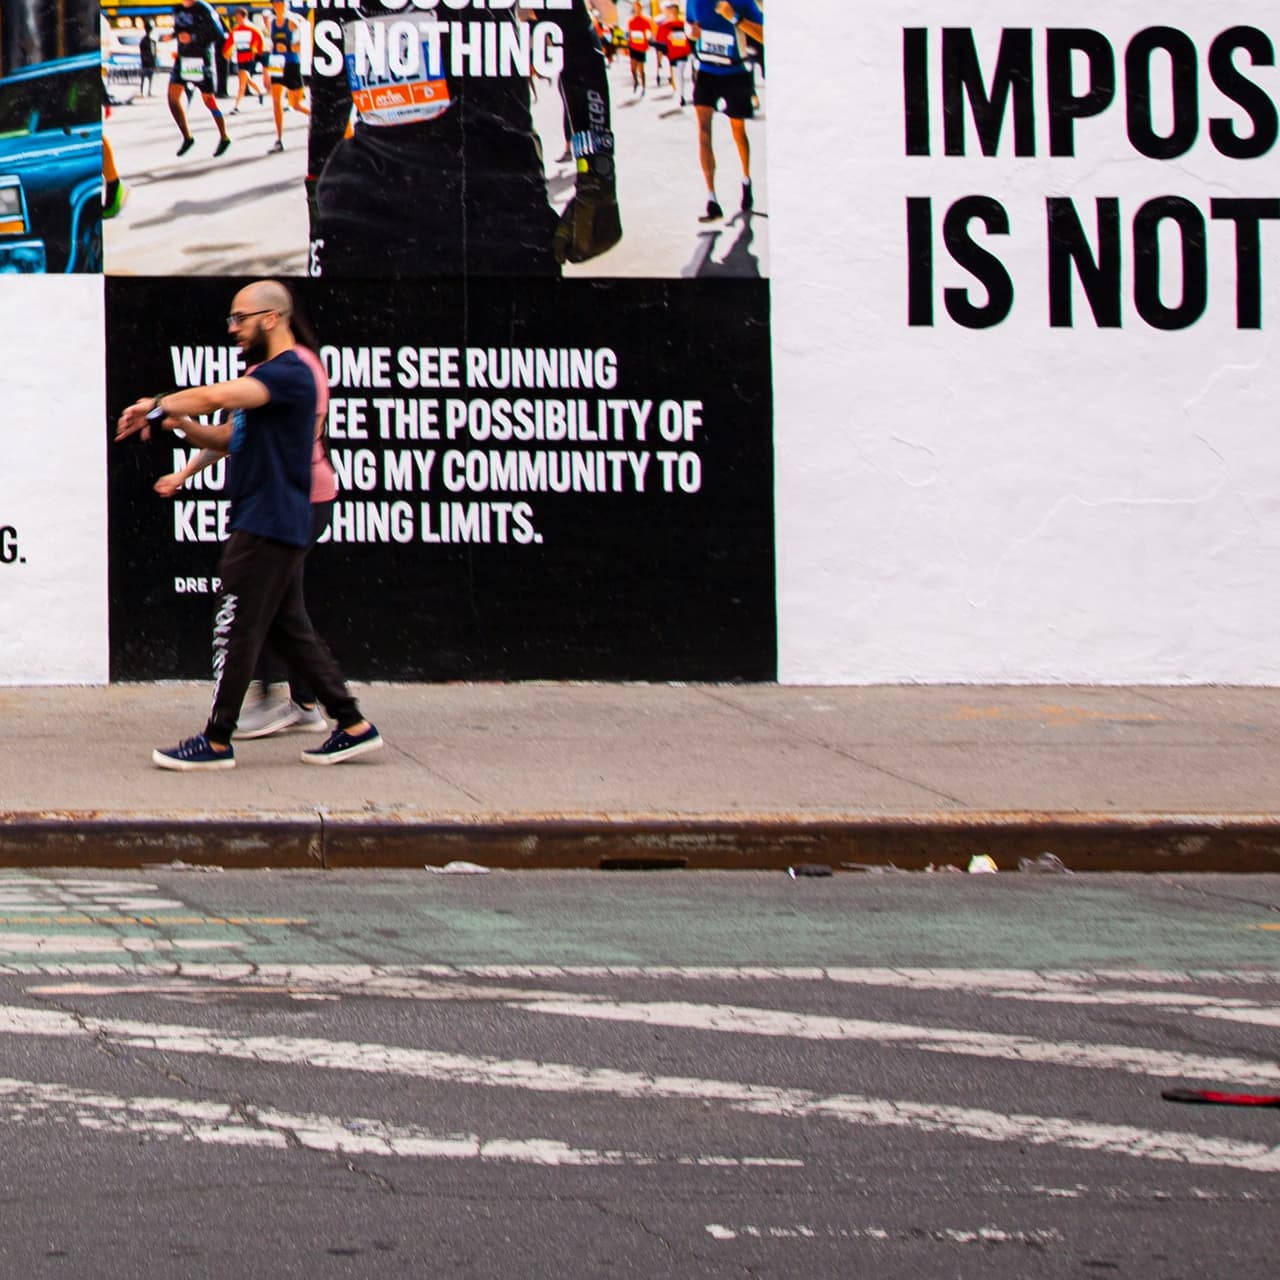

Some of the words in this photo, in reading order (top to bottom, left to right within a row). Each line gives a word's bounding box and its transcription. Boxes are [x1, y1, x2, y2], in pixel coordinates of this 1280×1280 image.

[302, 21, 343, 77] IS
[355, 21, 565, 78] NOTHING
[903, 25, 1278, 160] IMPOS
[906, 195, 1014, 330] IS
[1046, 195, 1280, 331] NOT
[171, 346, 247, 388] WHE
[320, 345, 391, 388] OME
[397, 346, 460, 389] SEE
[465, 347, 617, 390] RUNNING
[326, 398, 367, 440] EE
[373, 399, 439, 440] THE
[446, 399, 652, 441] POSSIBILITY
[659, 400, 703, 442] OF
[383, 450, 436, 491] MY
[442, 450, 649, 493] COMMUNITY
[656, 451, 701, 493] TO
[173, 501, 232, 542] KEE
[317, 501, 414, 543] HING
[420, 501, 543, 544] LIMITS.
[174, 577, 208, 593] DRE
